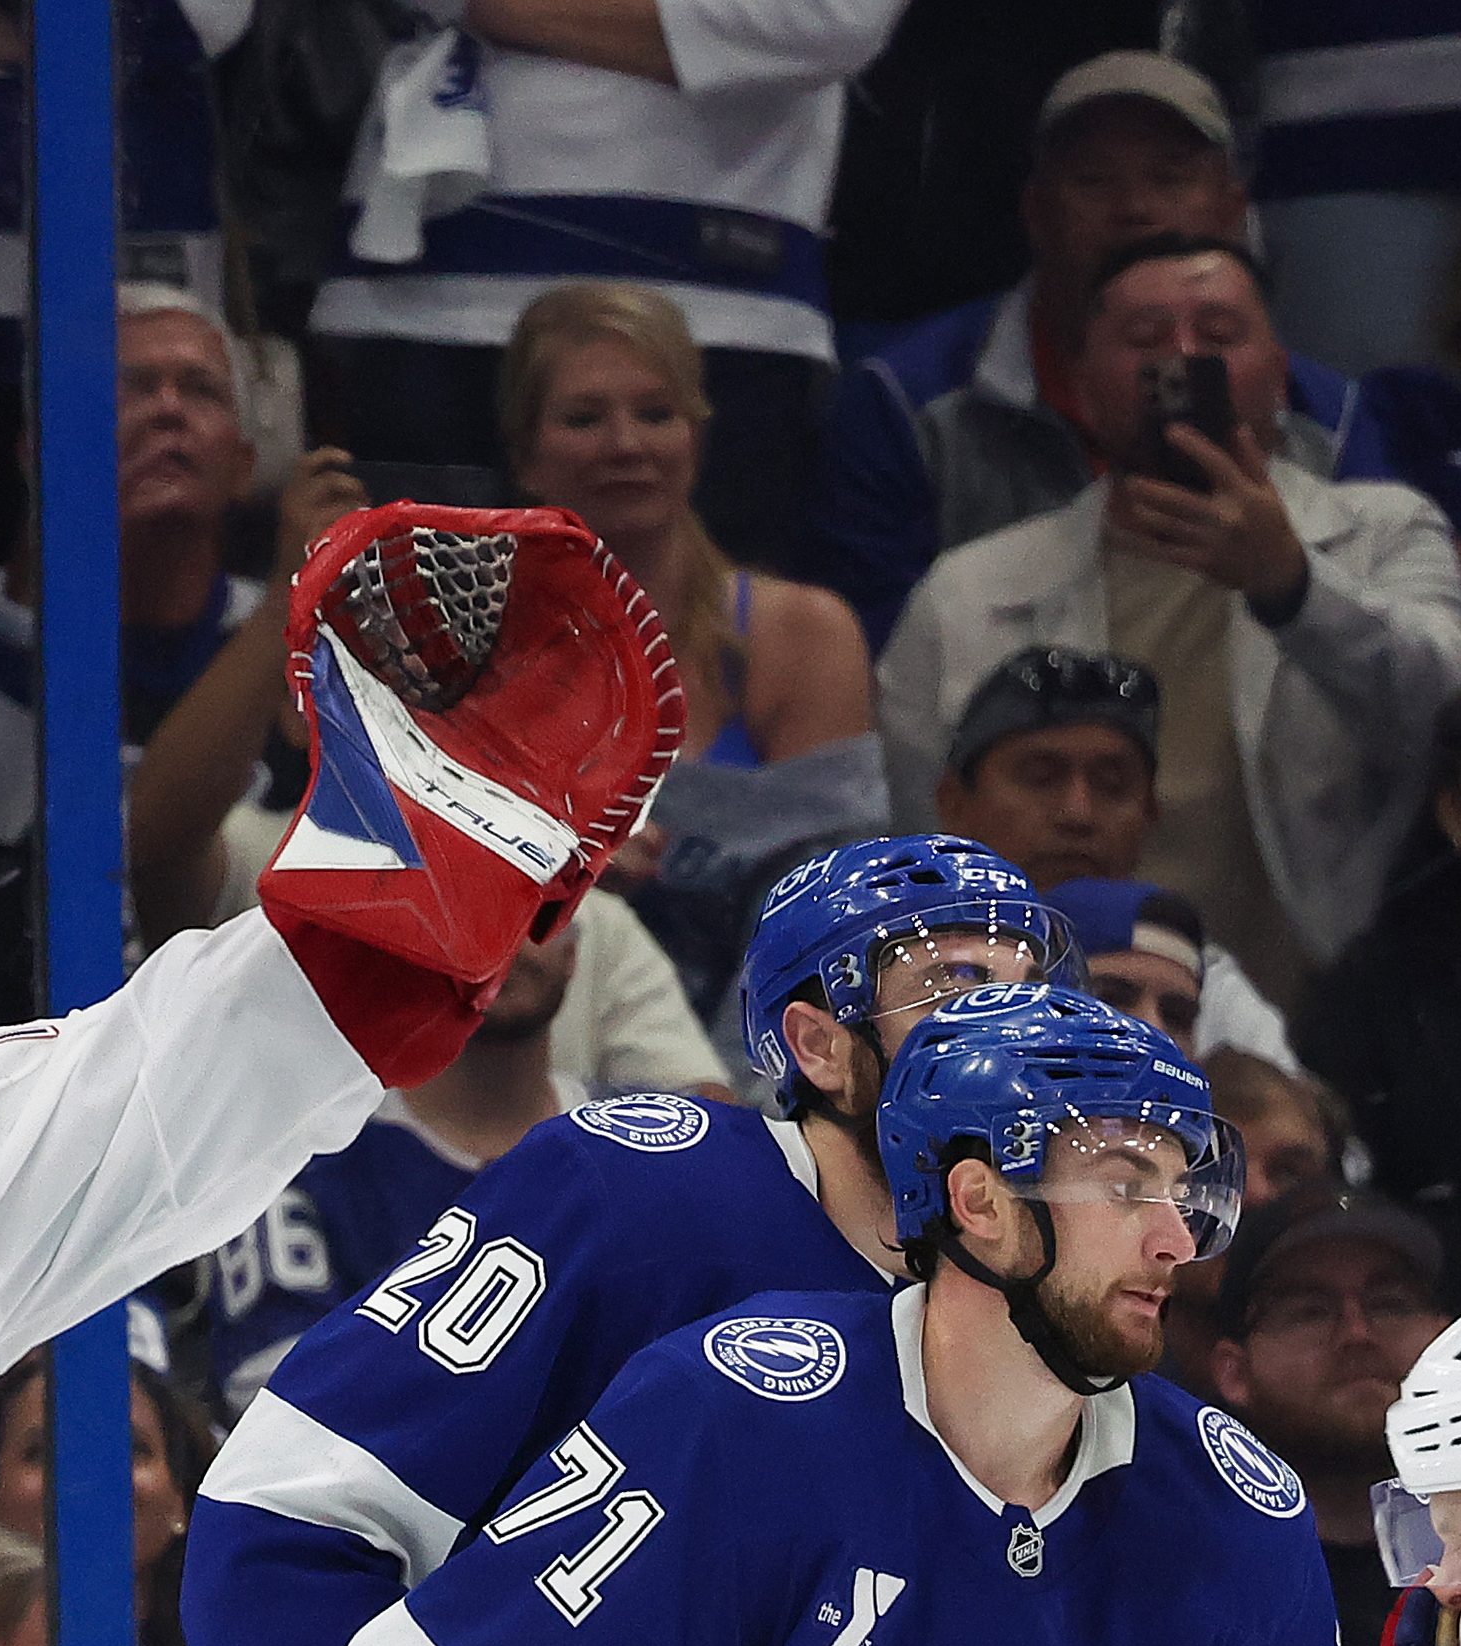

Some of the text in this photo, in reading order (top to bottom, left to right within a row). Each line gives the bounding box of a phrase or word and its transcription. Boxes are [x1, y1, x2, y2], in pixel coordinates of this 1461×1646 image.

[415, 772, 555, 870] TRUE
[961, 867, 1028, 890] CCM
[353, 1205, 547, 1375] 20
[721, 1320, 785, 1337] TAMPA
[790, 1323, 830, 1339] BAY
[762, 1341, 838, 1393] LIGHTNING
[1235, 1471, 1286, 1508] TAMPA
[482, 1420, 665, 1628] 71
[817, 1602, 843, 1627] the
